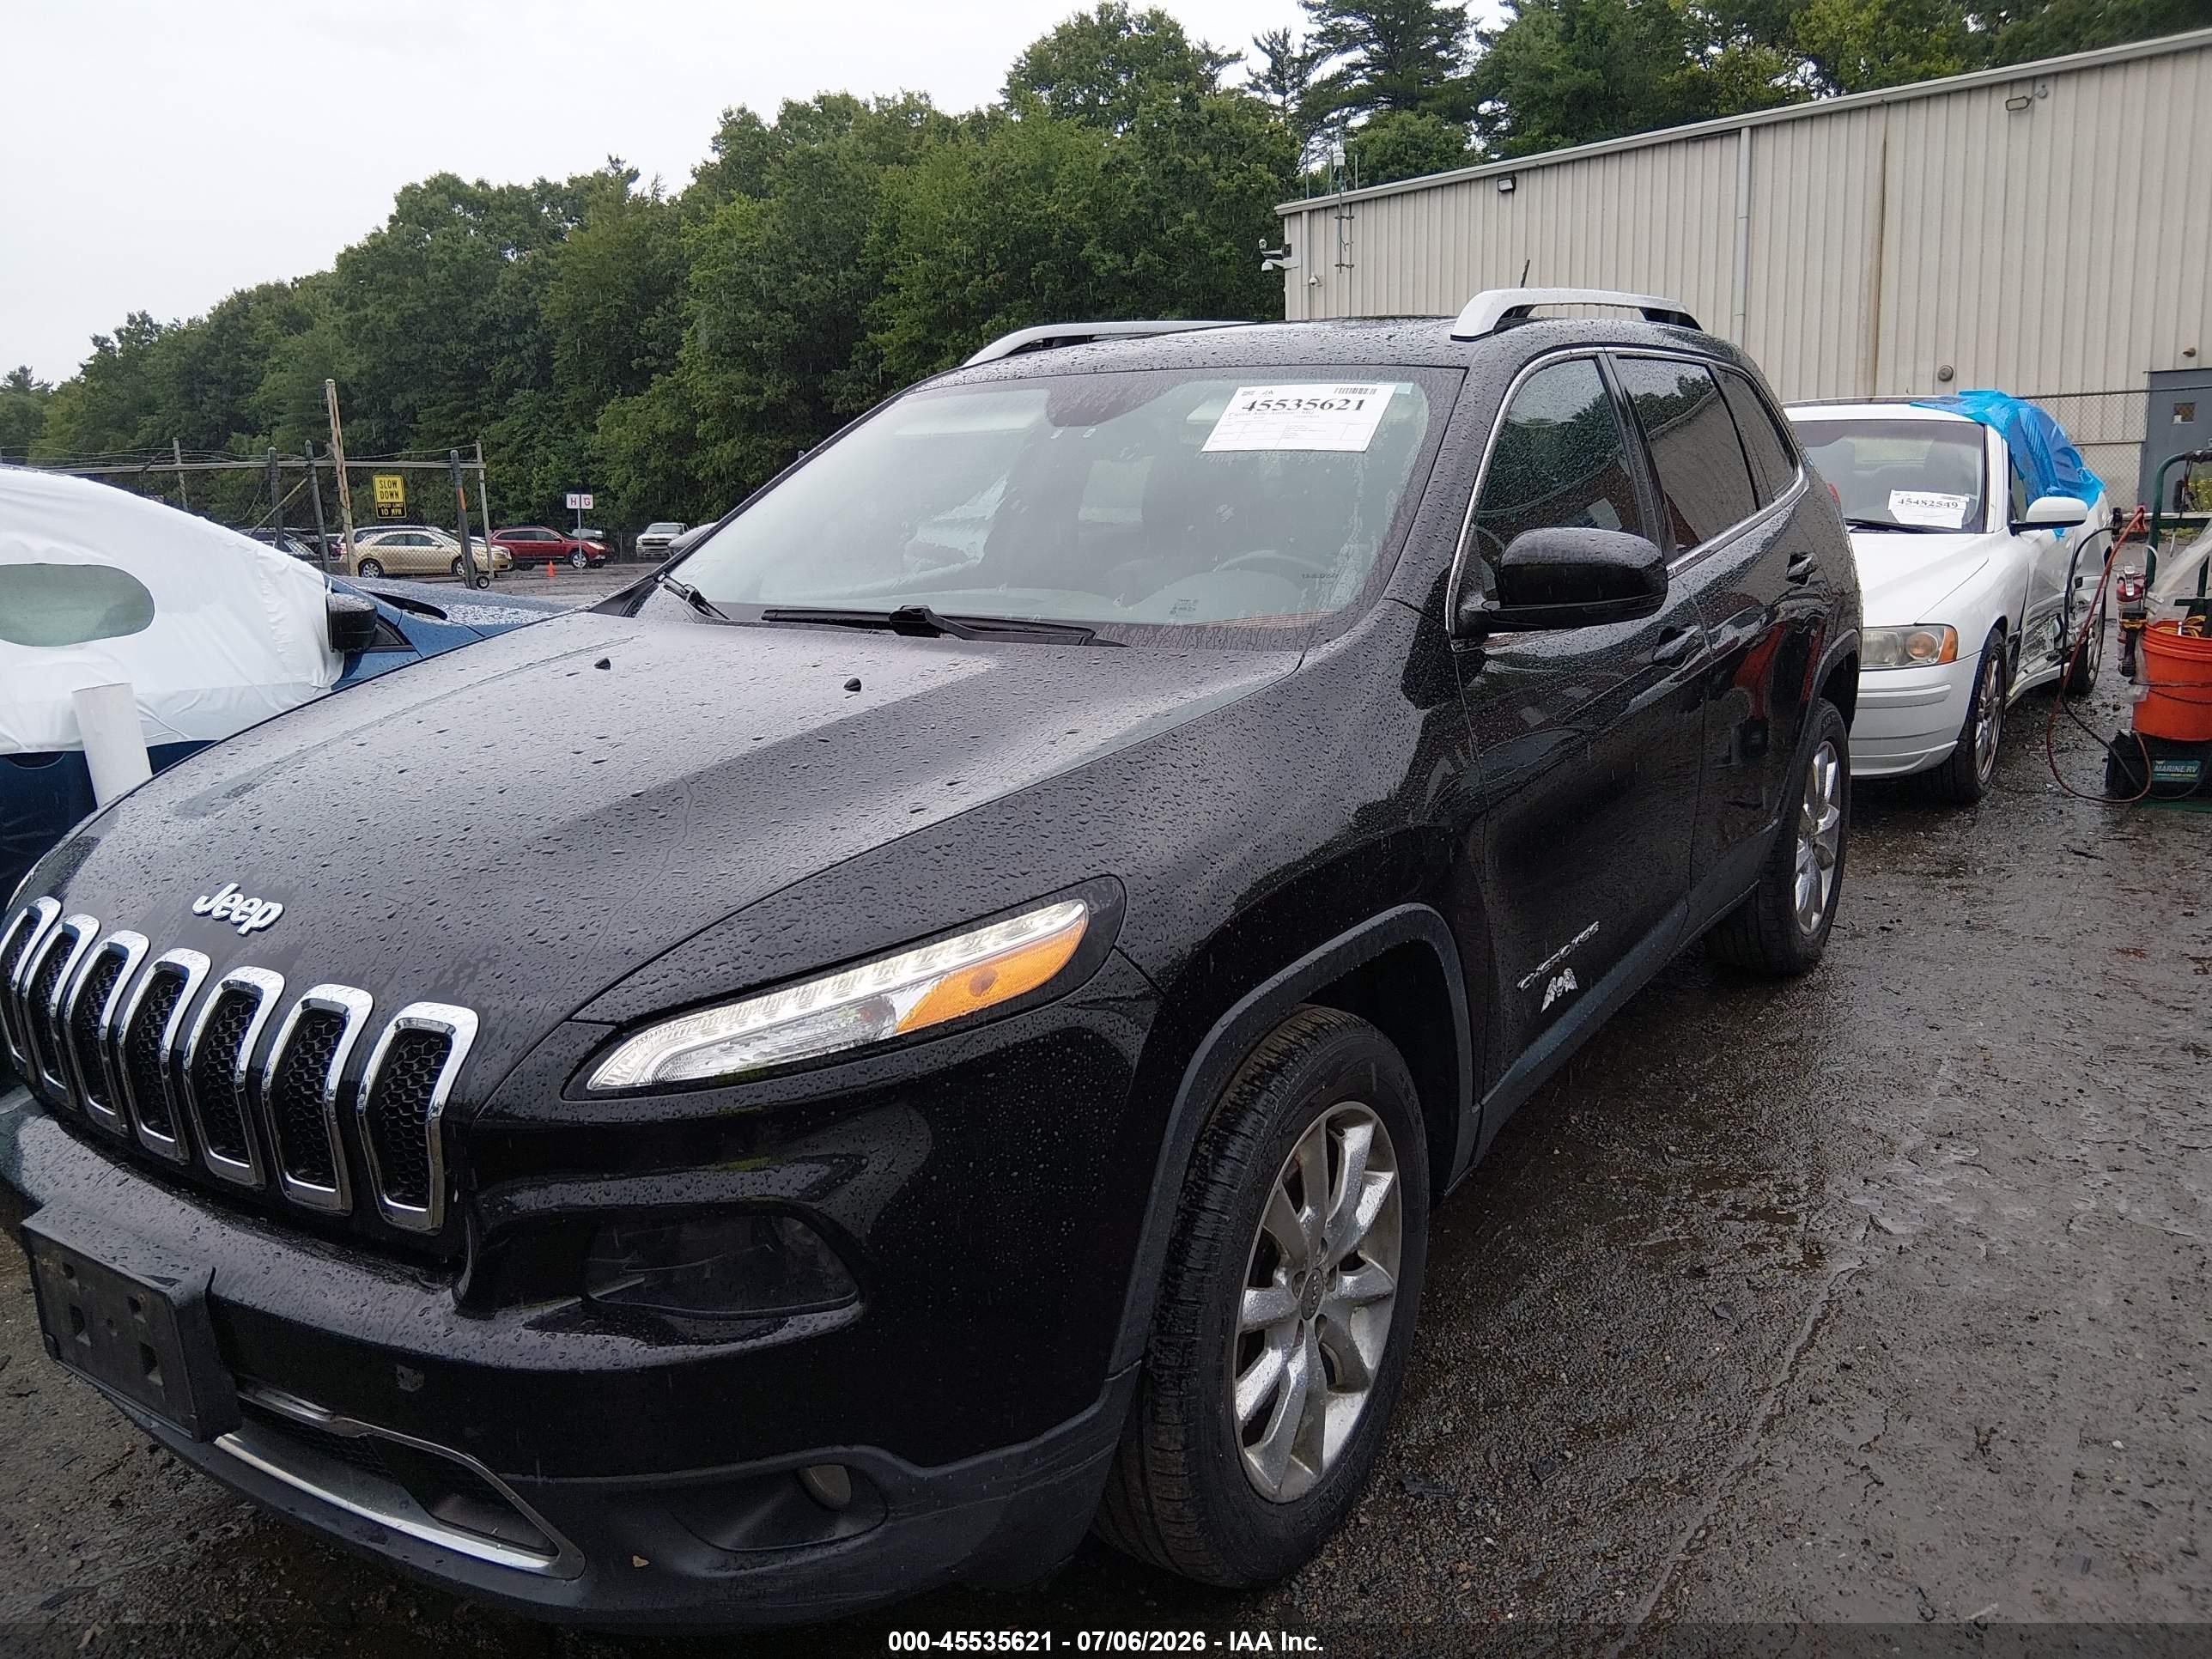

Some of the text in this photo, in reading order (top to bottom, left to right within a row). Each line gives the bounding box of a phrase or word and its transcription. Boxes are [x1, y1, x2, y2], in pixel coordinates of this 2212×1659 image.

[1242, 398, 1365, 411] 45535621
[380, 480, 398, 489] SLOW
[380, 491, 399, 500] DOWN
[570, 497, 577, 506] H
[584, 497, 591, 507] G
[1898, 498, 1959, 508] 45482549
[192, 883, 284, 935] Jeep
